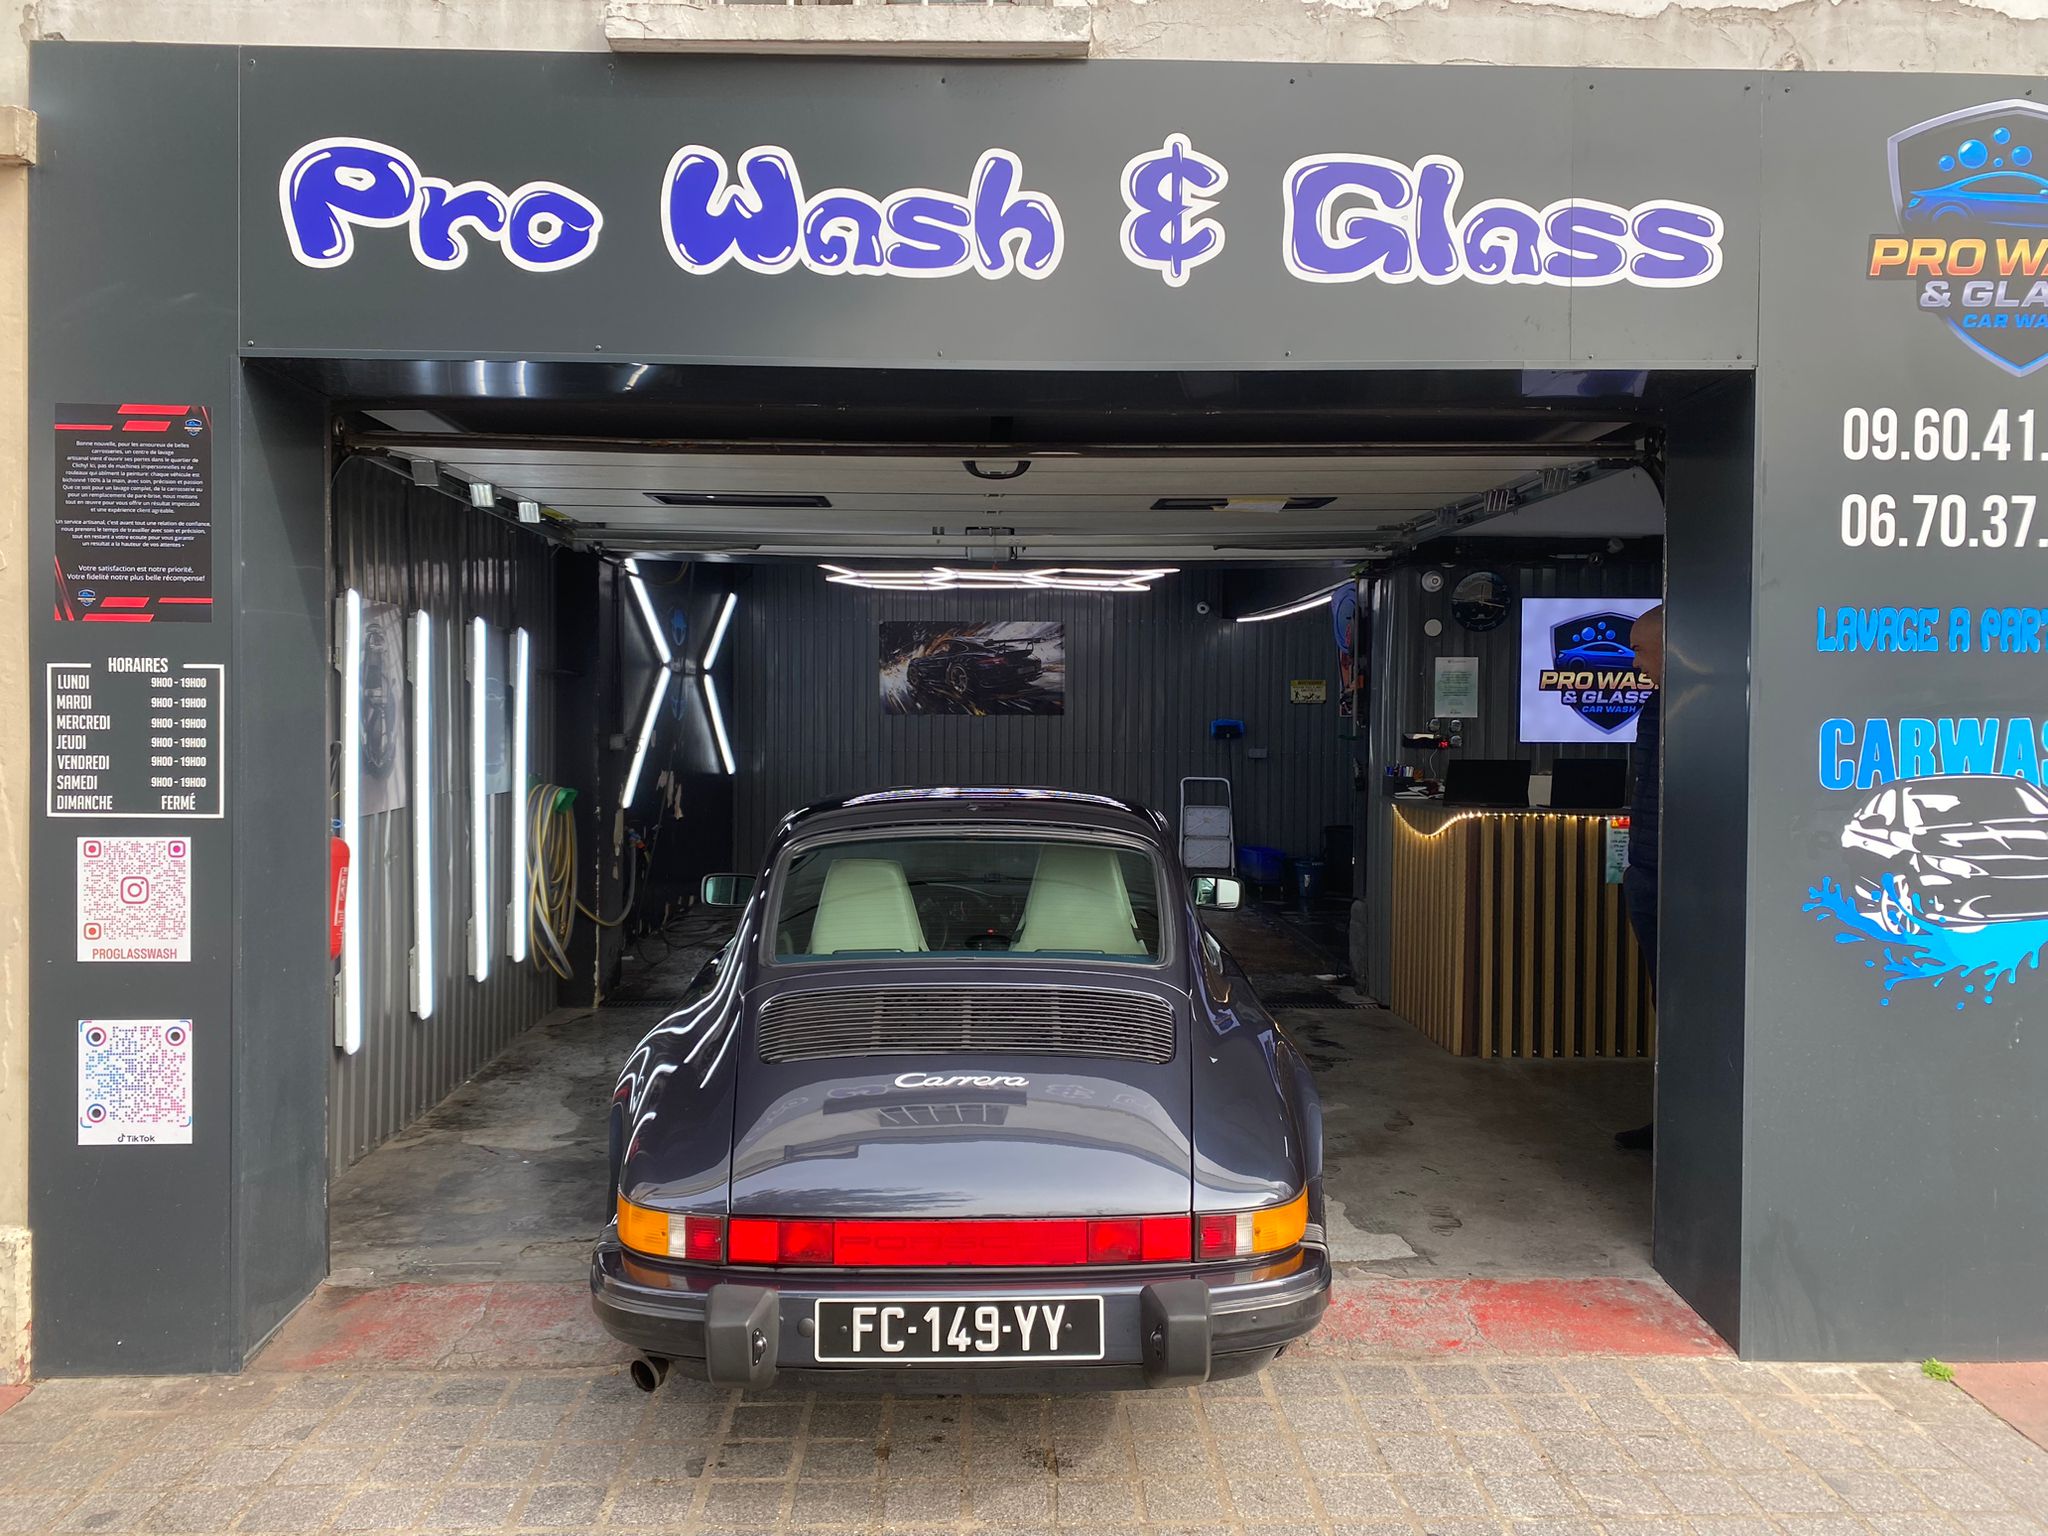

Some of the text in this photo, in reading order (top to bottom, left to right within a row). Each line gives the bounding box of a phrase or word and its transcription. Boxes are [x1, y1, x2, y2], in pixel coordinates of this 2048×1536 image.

[279, 132, 1724, 289] Pro Wash & Glass
[1870, 239, 2048, 276] PRO W
[1920, 281, 1951, 307] &
[1963, 314, 2008, 328] CAR
[1817, 606, 1939, 652] LAVAGE
[1949, 606, 1970, 652] A
[108, 657, 168, 673] HORAIRES
[58, 675, 206, 689] LUNDI 9H00 19H00
[1540, 672, 1659, 689] PRO WAS
[56, 695, 206, 709] MARDI 9H00 19H00
[1563, 691, 1577, 703] &
[56, 715, 206, 730] MERCREDI 9H00 19H00
[56, 735, 206, 749] JEUDI 9H00 19H00
[1818, 717, 2048, 790] CARWA
[57, 755, 206, 769] VENDREDI 9H00 19H00
[56, 776, 206, 789] SAMEDI 9H00 19H00
[56, 793, 195, 810] DIMANCHE FERMÉ
[92, 948, 177, 960] PROGLASSWASH
[894, 1073, 1029, 1088] Carrera
[850, 1305, 1067, 1354] FC-149-YY
